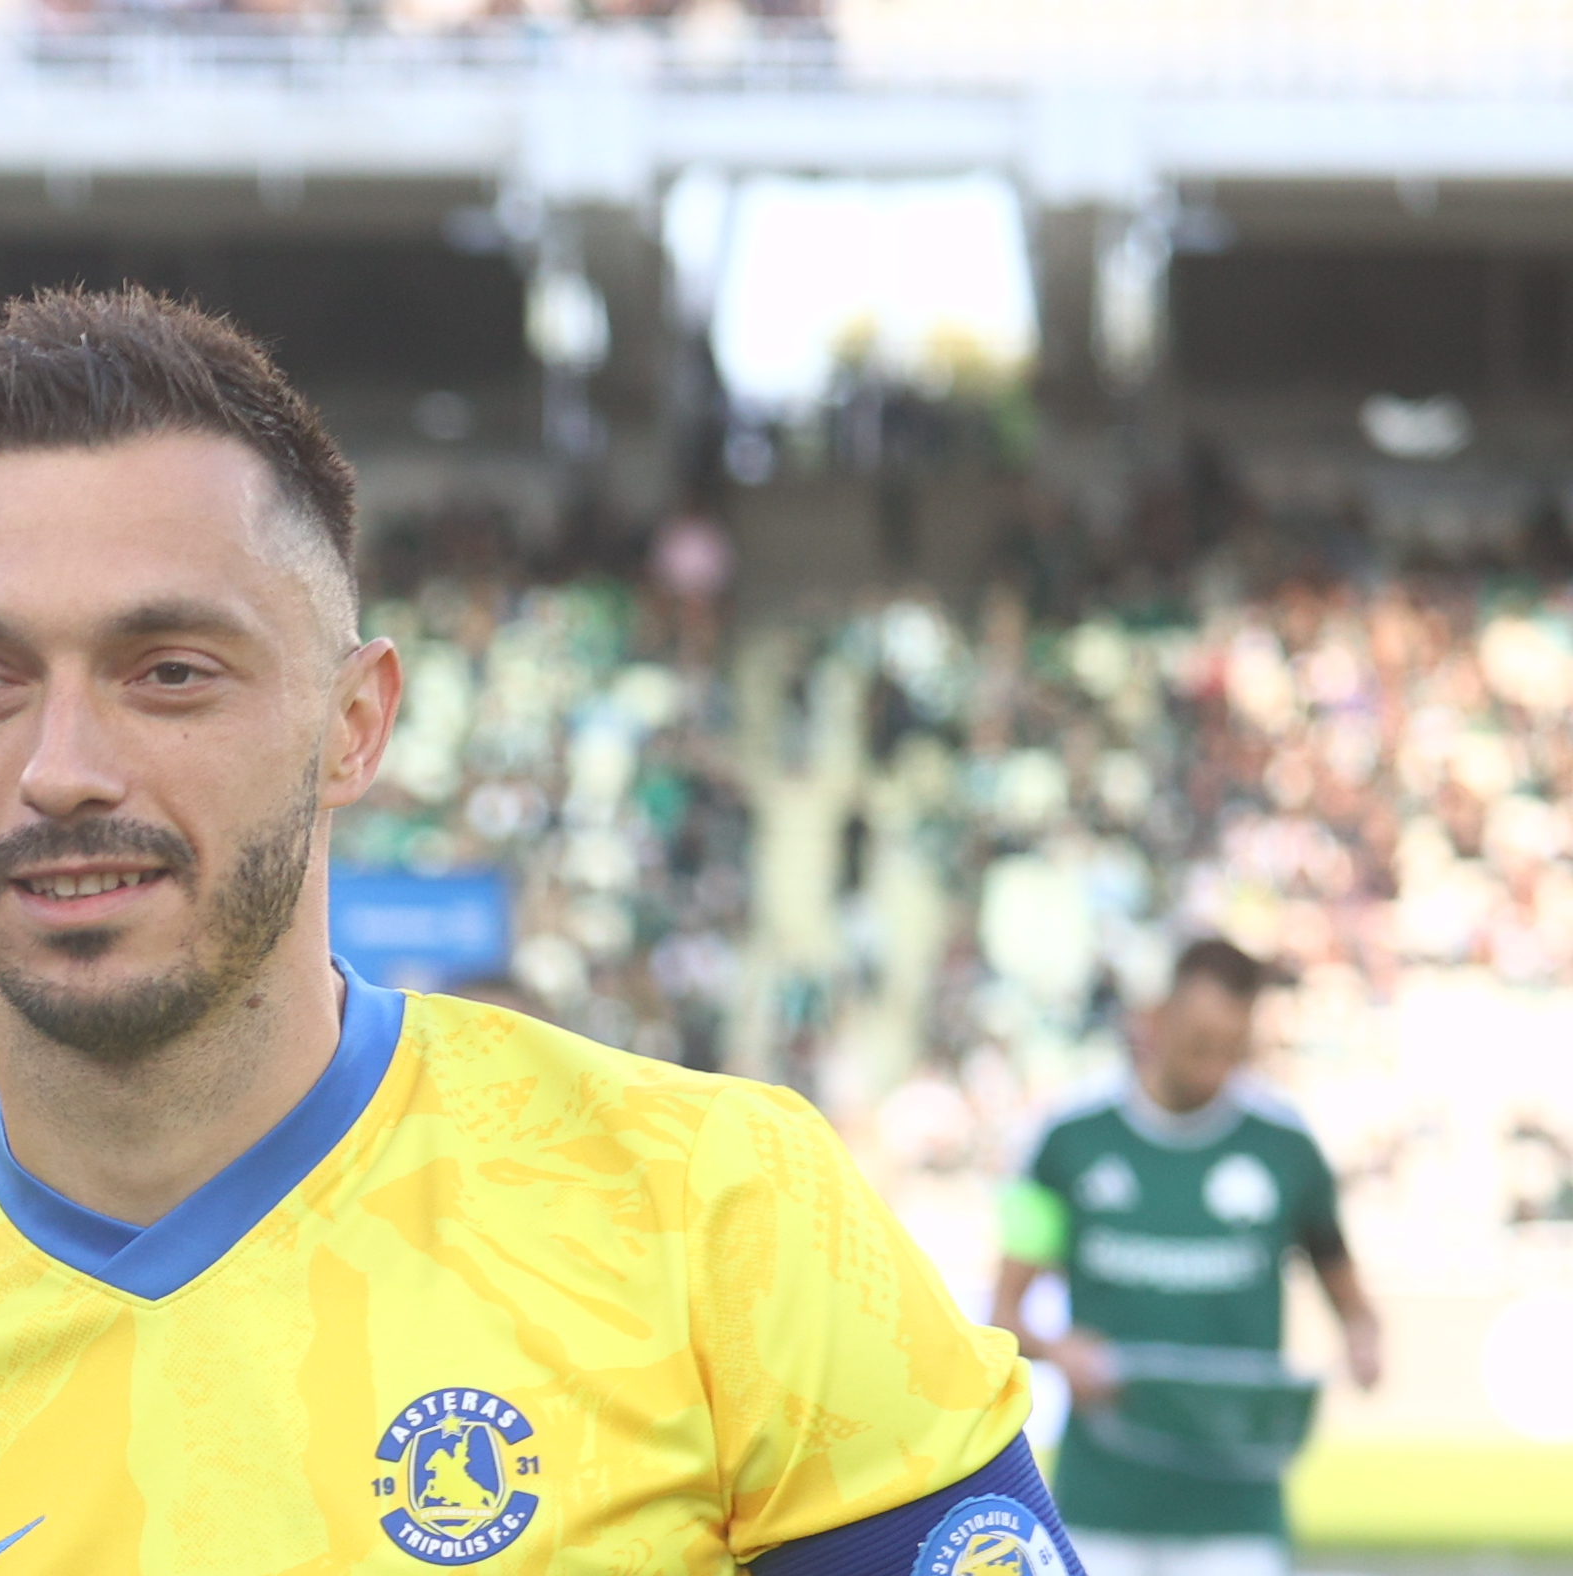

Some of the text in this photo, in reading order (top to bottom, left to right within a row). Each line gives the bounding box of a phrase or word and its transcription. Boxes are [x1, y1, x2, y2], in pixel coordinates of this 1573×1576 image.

[390, 1391, 519, 1444] ASTERAS
[516, 1456, 540, 1476] 31
[371, 1477, 395, 1497] 19
[398, 1512, 527, 1558] TRIPOLIS F.C.
[949, 1511, 1021, 1546] TRIPOLIS
